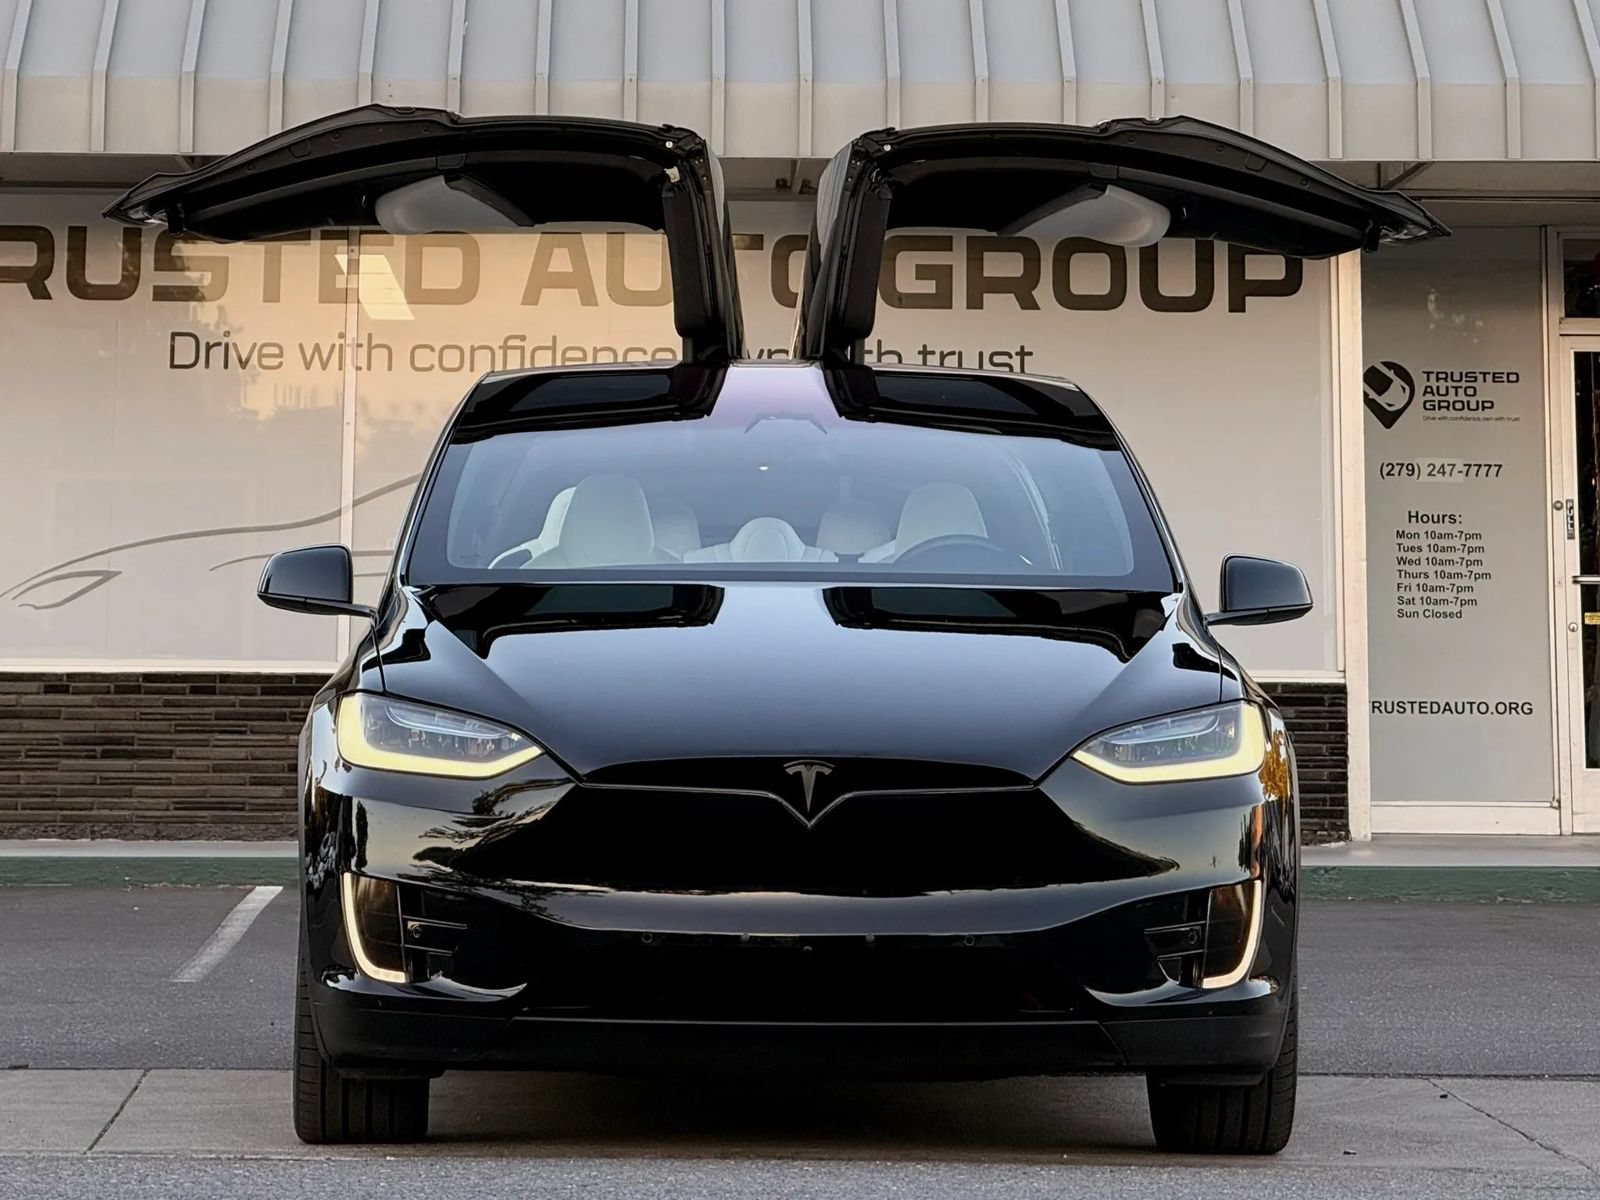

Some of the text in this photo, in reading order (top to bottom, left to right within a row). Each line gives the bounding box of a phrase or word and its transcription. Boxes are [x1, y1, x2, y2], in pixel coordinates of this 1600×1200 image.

[879, 234, 1303, 313] GROUP
[169, 330, 284, 370] Drive
[1422, 371, 1520, 383] TRUSTED
[1422, 385, 1477, 397] AUTO
[1423, 400, 1495, 412] GROUP
[1380, 462, 1503, 480] (279) 247-7777
[1408, 510, 1462, 524] Hours:
[1396, 530, 1482, 542] Mon 10am-7pm
[1396, 543, 1485, 555] Tues 10am-7pm
[1396, 556, 1483, 568] Wed 10am-7pm
[1396, 569, 1491, 581] Thurs 10am-7pm
[1397, 583, 1474, 594] Fri 10am-7pm
[1397, 596, 1477, 607] Sat 10am-7pm
[1397, 608, 1462, 619] Sun Closed
[1369, 700, 1533, 715] RUSTEDAUTO.ORG
